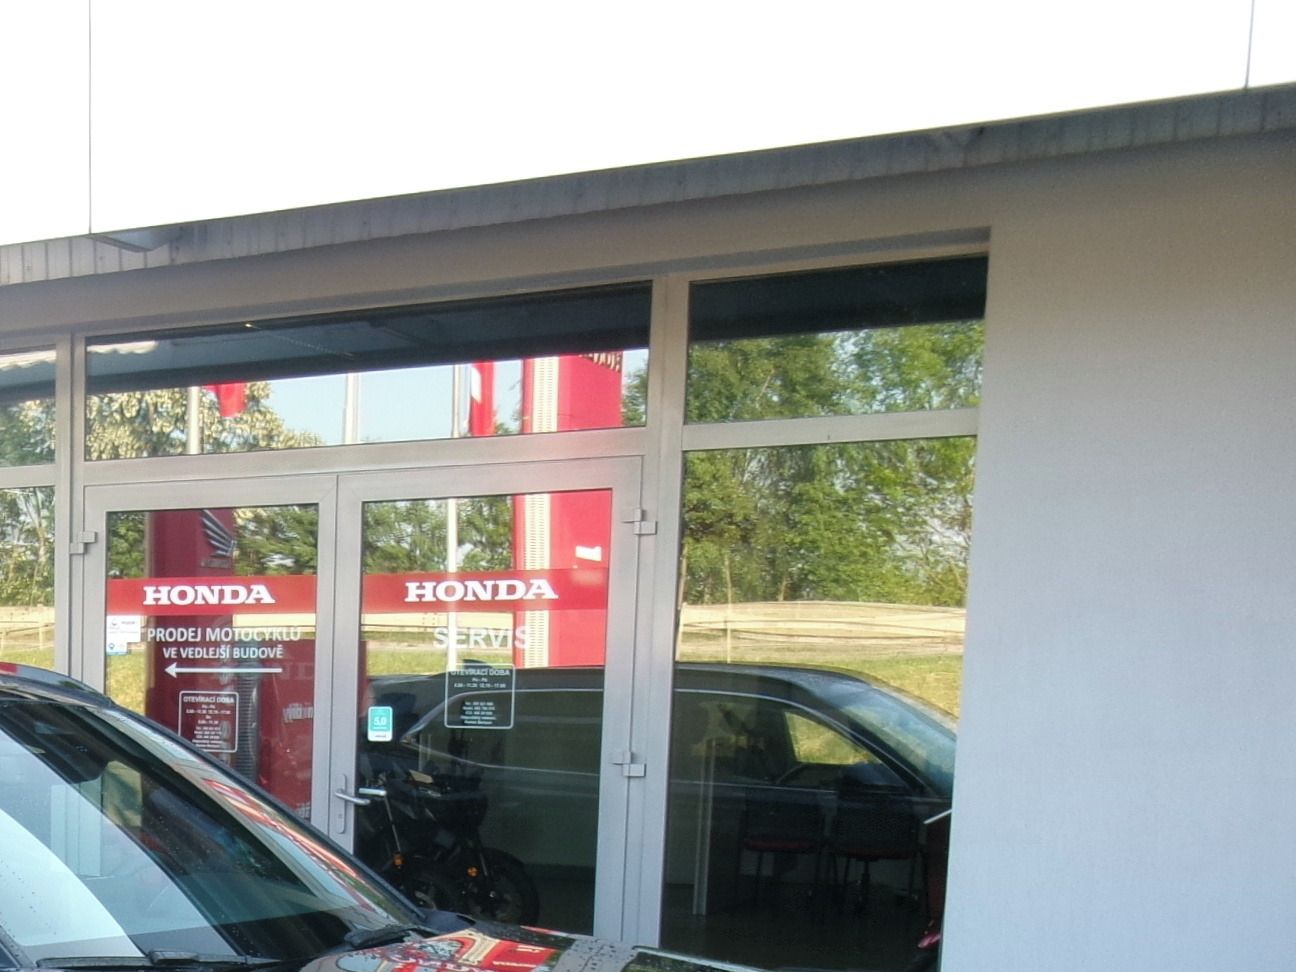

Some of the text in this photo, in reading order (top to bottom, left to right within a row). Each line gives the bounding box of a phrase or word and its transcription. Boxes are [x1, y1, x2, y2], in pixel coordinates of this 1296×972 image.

[142, 584, 276, 605] HONDA
[404, 579, 559, 602] HONDA
[147, 627, 202, 642] PRODEJ
[432, 626, 530, 649] SERVIS
[163, 644, 284, 659] VE VEDLEJŠÍ BUDOVĚ
